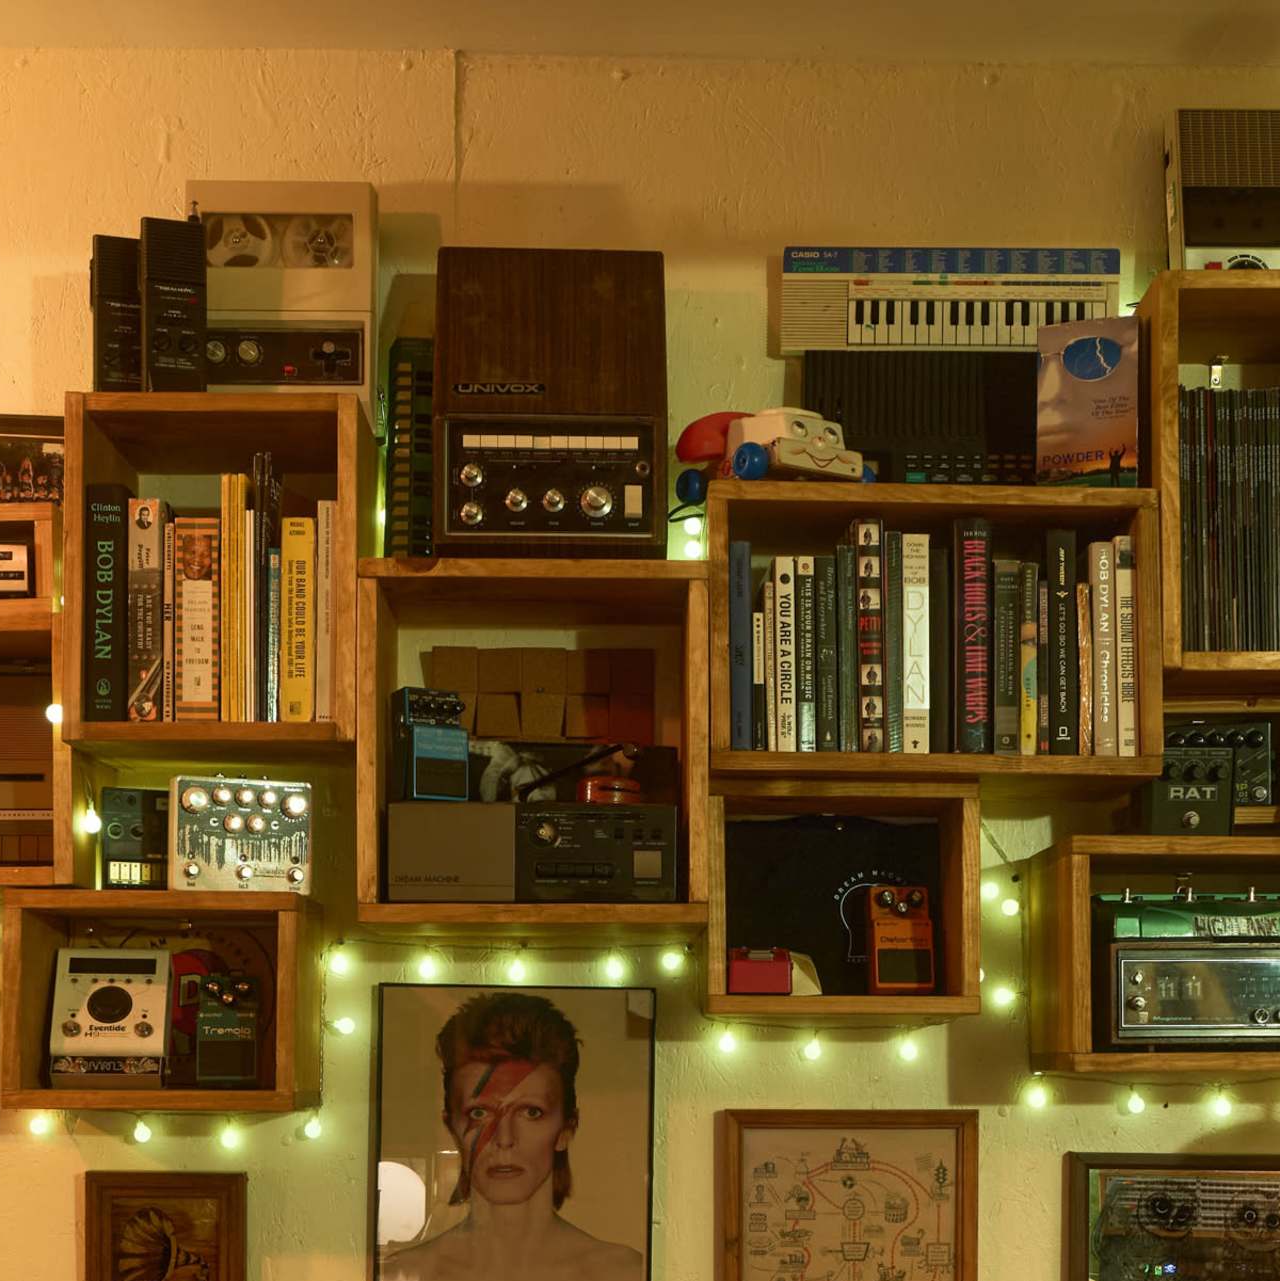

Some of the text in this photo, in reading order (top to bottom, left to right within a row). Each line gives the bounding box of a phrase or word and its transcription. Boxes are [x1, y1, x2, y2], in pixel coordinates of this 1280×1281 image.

[458, 384, 540, 393] UNIVOX
[1042, 450, 1105, 465] POWDER
[91, 503, 121, 512] Clinton
[93, 513, 121, 524] Heylin
[963, 540, 987, 580] BLACK
[95, 540, 114, 660] BOB DYLAN
[826, 567, 834, 611] Here, There
[164, 603, 172, 622] HER
[805, 599, 812, 608] IS
[963, 582, 987, 622] HOLES
[1099, 584, 1110, 633] DYLAN
[296, 560, 306, 679] OUR BAND COULD BE YOUR LIFE
[818, 597, 826, 640] Everywhere
[963, 624, 987, 643] &
[780, 594, 792, 704] YOU ARE A CIRCLE
[906, 591, 925, 704] DYLAN
[1059, 648, 1067, 660] WE
[1120, 596, 1136, 704] THE SOUND EFFECTS BIBLE
[805, 661, 812, 672] ON
[963, 645, 987, 673] TIME
[1059, 660, 1067, 675] CAN
[1059, 677, 1067, 690] GET
[1100, 650, 1110, 723] Chronicles
[963, 677, 987, 723] WARPS
[1059, 691, 1067, 713] BACK)
[1170, 787, 1216, 799] RAT
[833, 871, 864, 900] DREAM
[88, 1024, 126, 1032] Eventide
[202, 1026, 251, 1035] Tremolo
